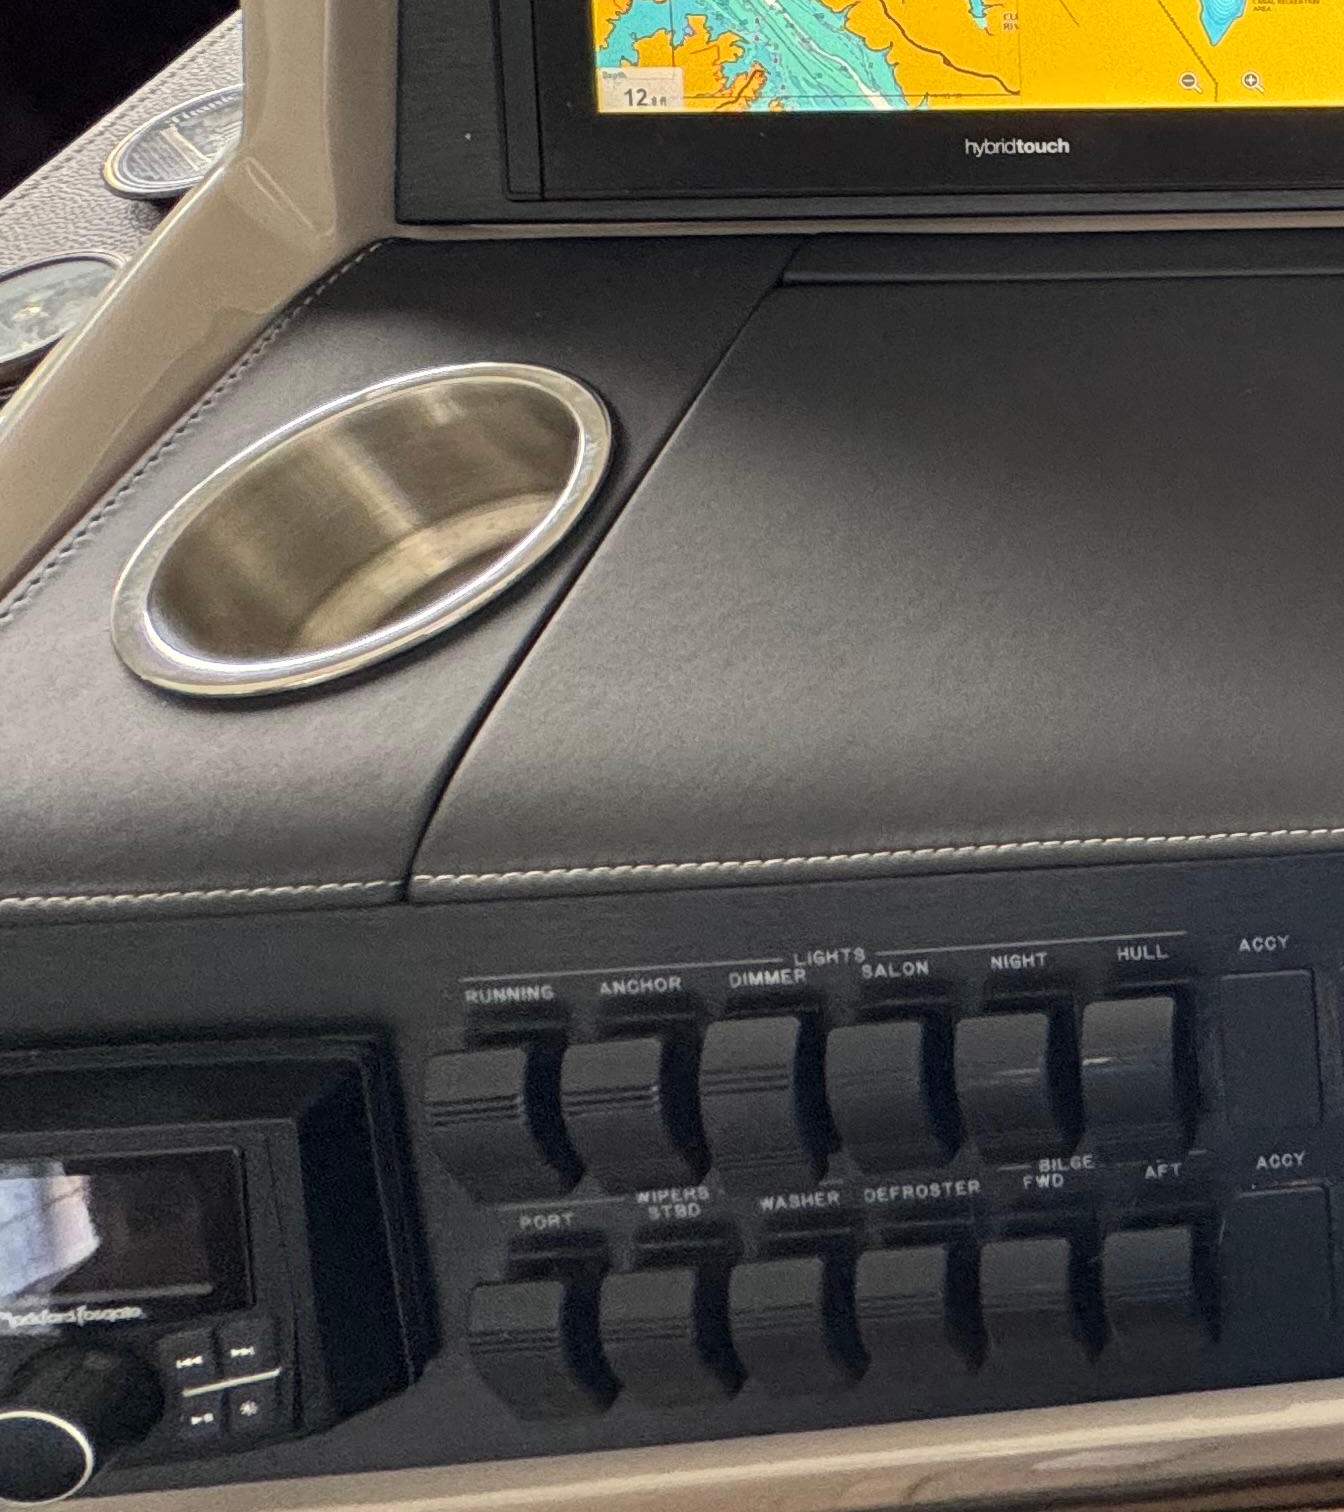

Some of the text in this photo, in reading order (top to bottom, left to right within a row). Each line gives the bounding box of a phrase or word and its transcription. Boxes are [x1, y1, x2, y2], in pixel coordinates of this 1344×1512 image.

[965, 137, 1070, 158] hybridtouch
[1116, 944, 1169, 962] HULL
[1239, 935, 1290, 953] ACCY
[794, 947, 866, 968] LIGHTS
[990, 952, 1049, 970] NIGHT
[728, 968, 807, 989] DIMMER
[861, 960, 930, 980] SALON
[464, 985, 555, 1004] RUNNING
[599, 976, 684, 995] ANCHOR
[1039, 1154, 1094, 1173] BILGE
[1144, 1161, 1184, 1180] AFT
[1255, 1151, 1307, 1171] ACCY
[1023, 1173, 1065, 1189] FWD
[636, 1186, 711, 1205] WIPERS
[759, 1190, 841, 1212] WASHER
[864, 1179, 982, 1205] DEFROSTER
[519, 1211, 575, 1230] PORT
[648, 1202, 701, 1221] STBD
